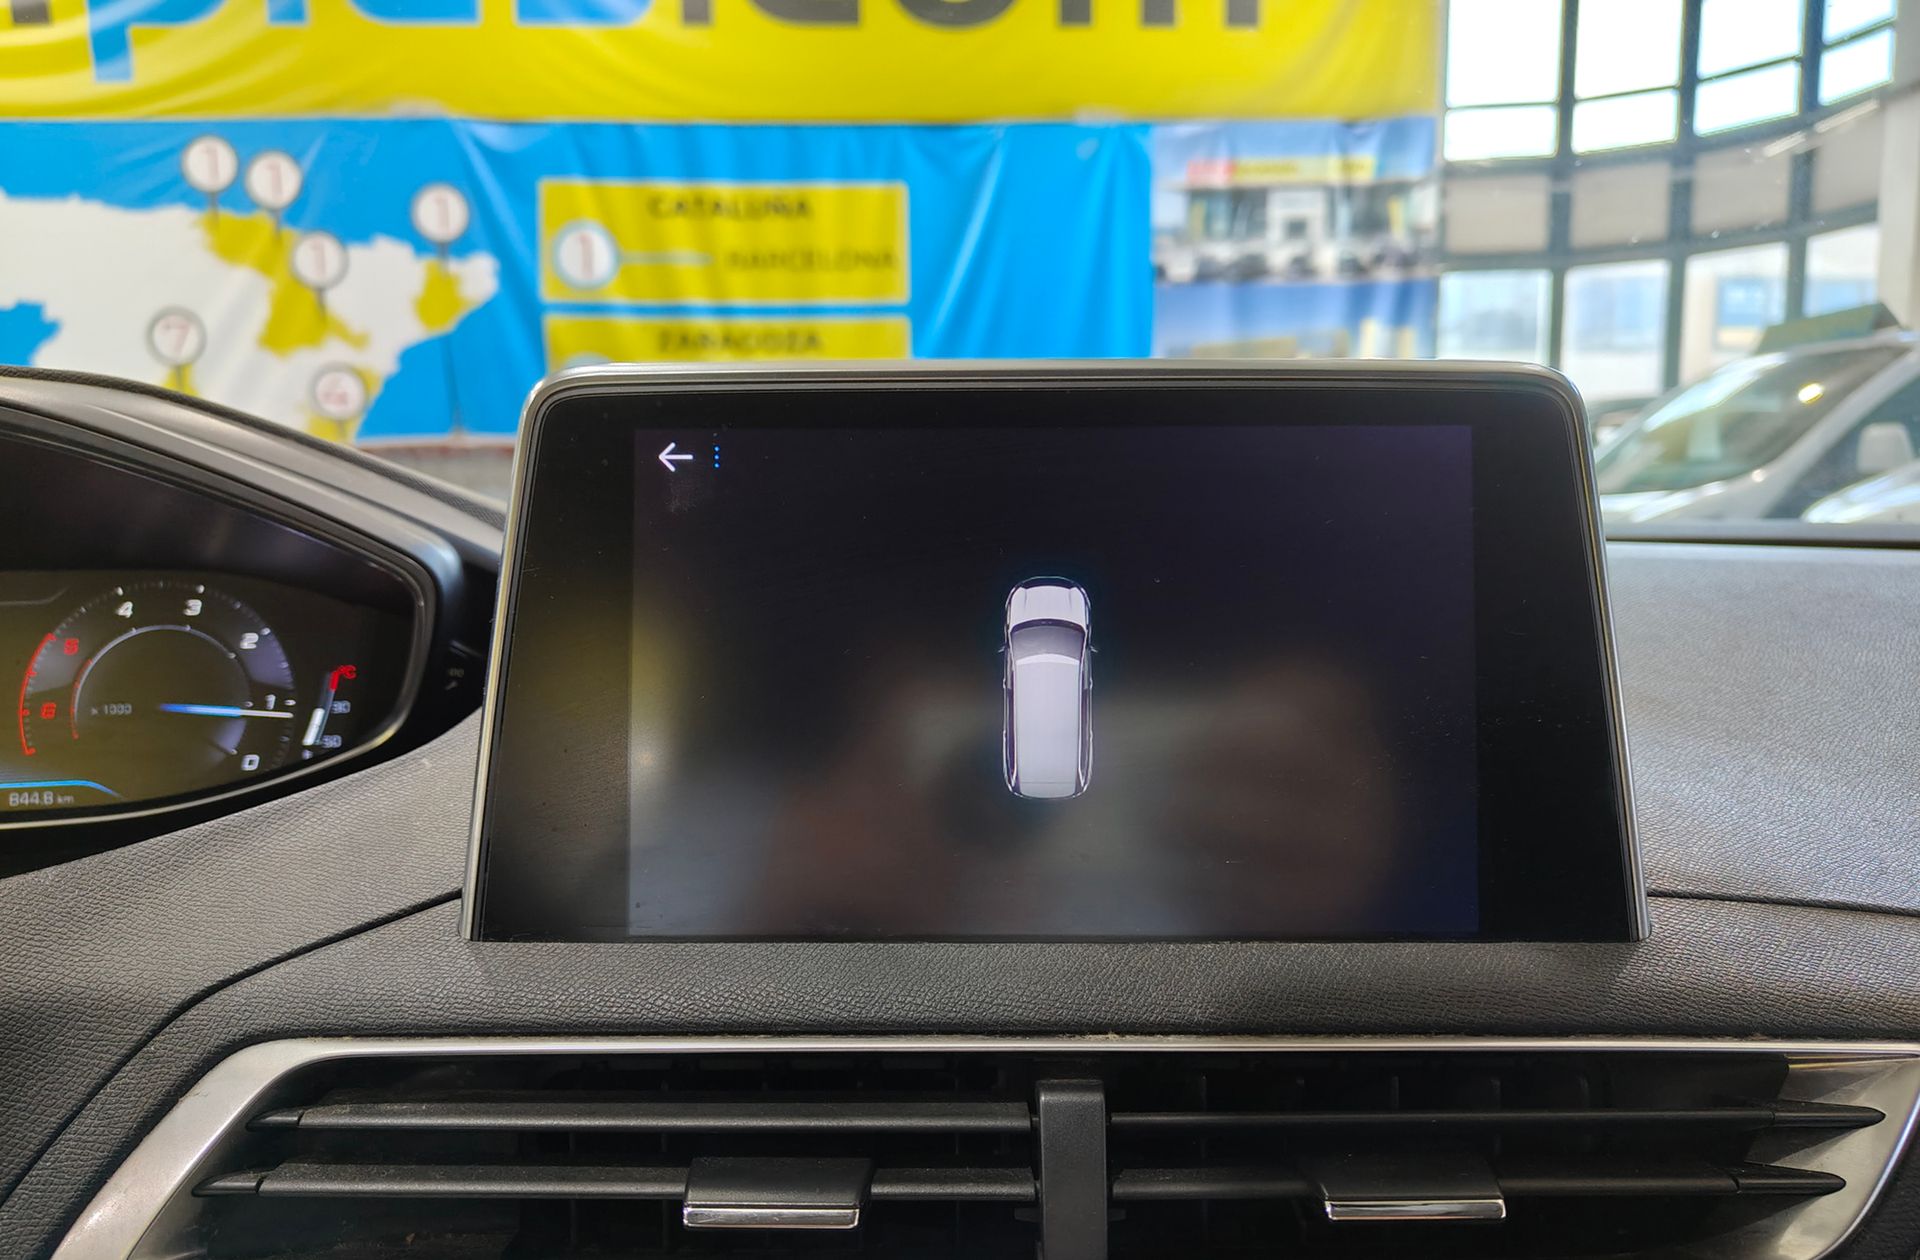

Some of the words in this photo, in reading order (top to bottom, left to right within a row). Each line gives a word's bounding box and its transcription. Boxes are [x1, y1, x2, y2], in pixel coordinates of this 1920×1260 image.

[115, 601, 134, 619] 4
[183, 599, 202, 616] 3
[64, 638, 79, 656] 5
[240, 632, 259, 650] 2
[103, 703, 133, 715] 1000
[265, 694, 277, 710] 1
[241, 754, 260, 771] 0
